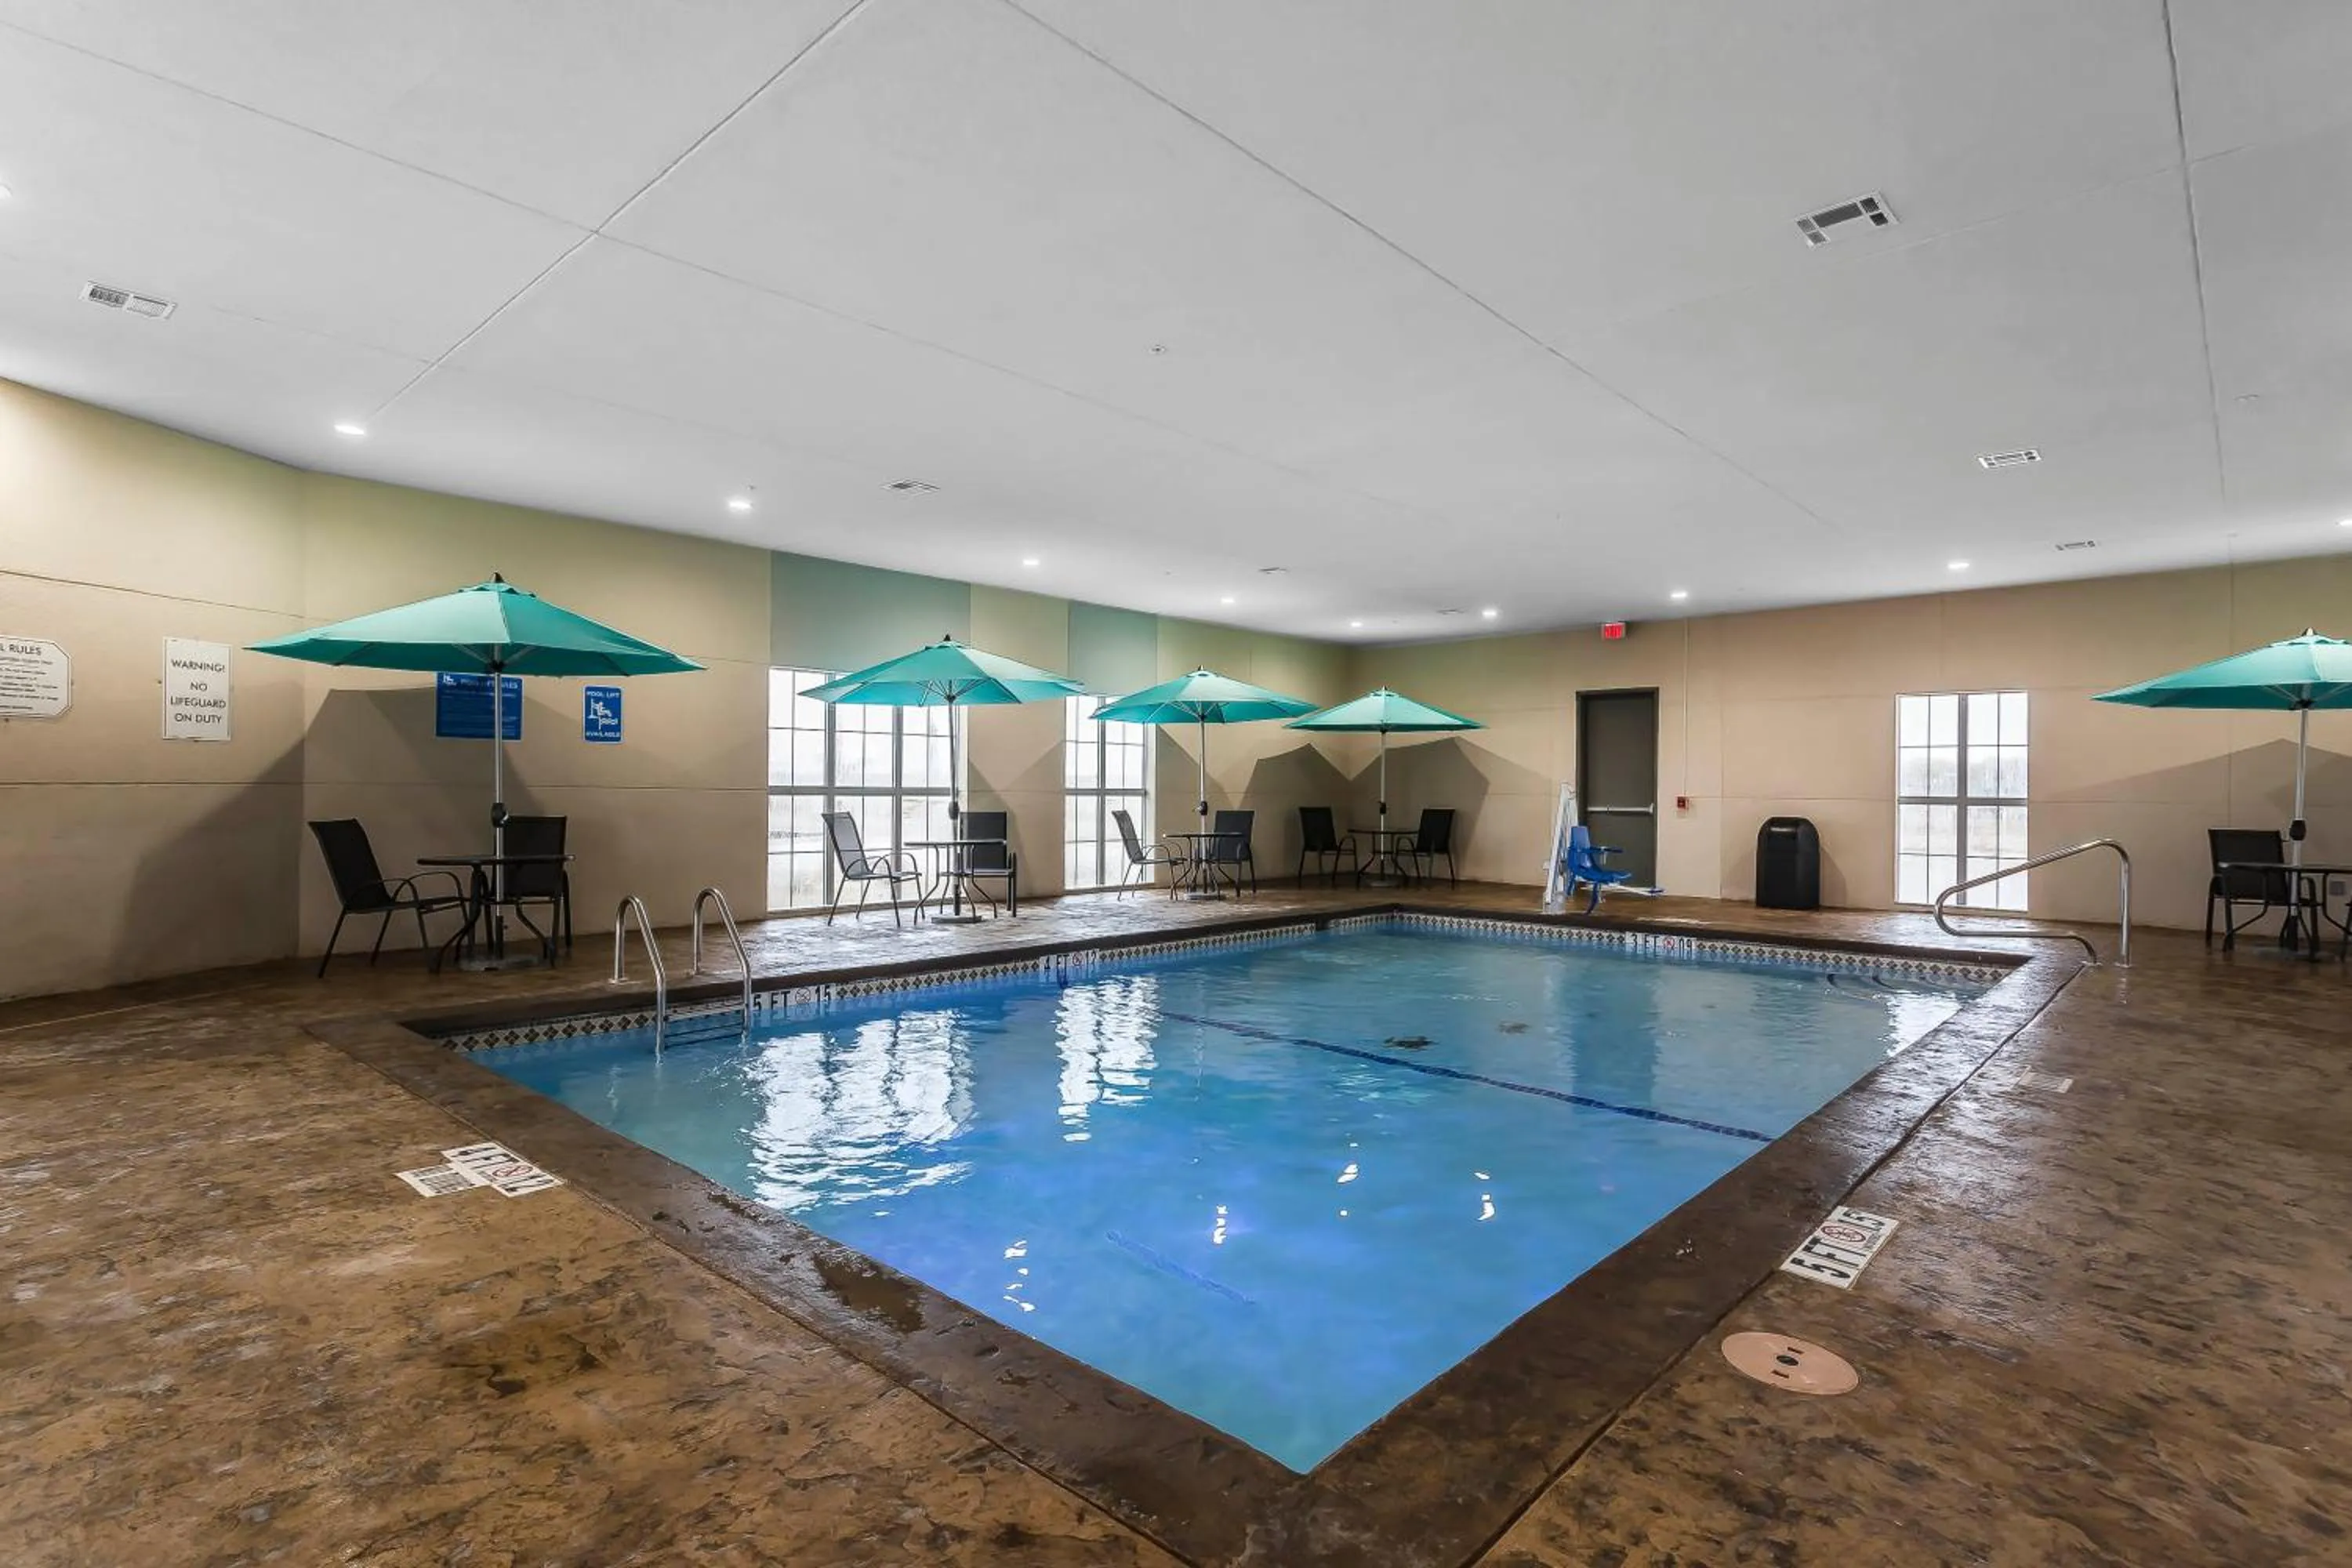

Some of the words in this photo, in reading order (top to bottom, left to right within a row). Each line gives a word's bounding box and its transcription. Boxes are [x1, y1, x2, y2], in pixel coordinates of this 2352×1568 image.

[9, 644, 42, 655] RULES
[171, 659, 225, 673] WARNING!
[191, 682, 207, 691] NO
[170, 696, 226, 709] LIFEGUARD
[175, 713, 191, 722] ON
[195, 714, 222, 723] DUTY
[1645, 935, 1659, 949] FT
[1057, 953, 1069, 967] FT
[753, 993, 762, 1011] 5
[771, 990, 790, 1010] FT
[1838, 1211, 1885, 1231] 15
[1803, 1237, 1867, 1266] FT
[1791, 1258, 1850, 1279] 5
